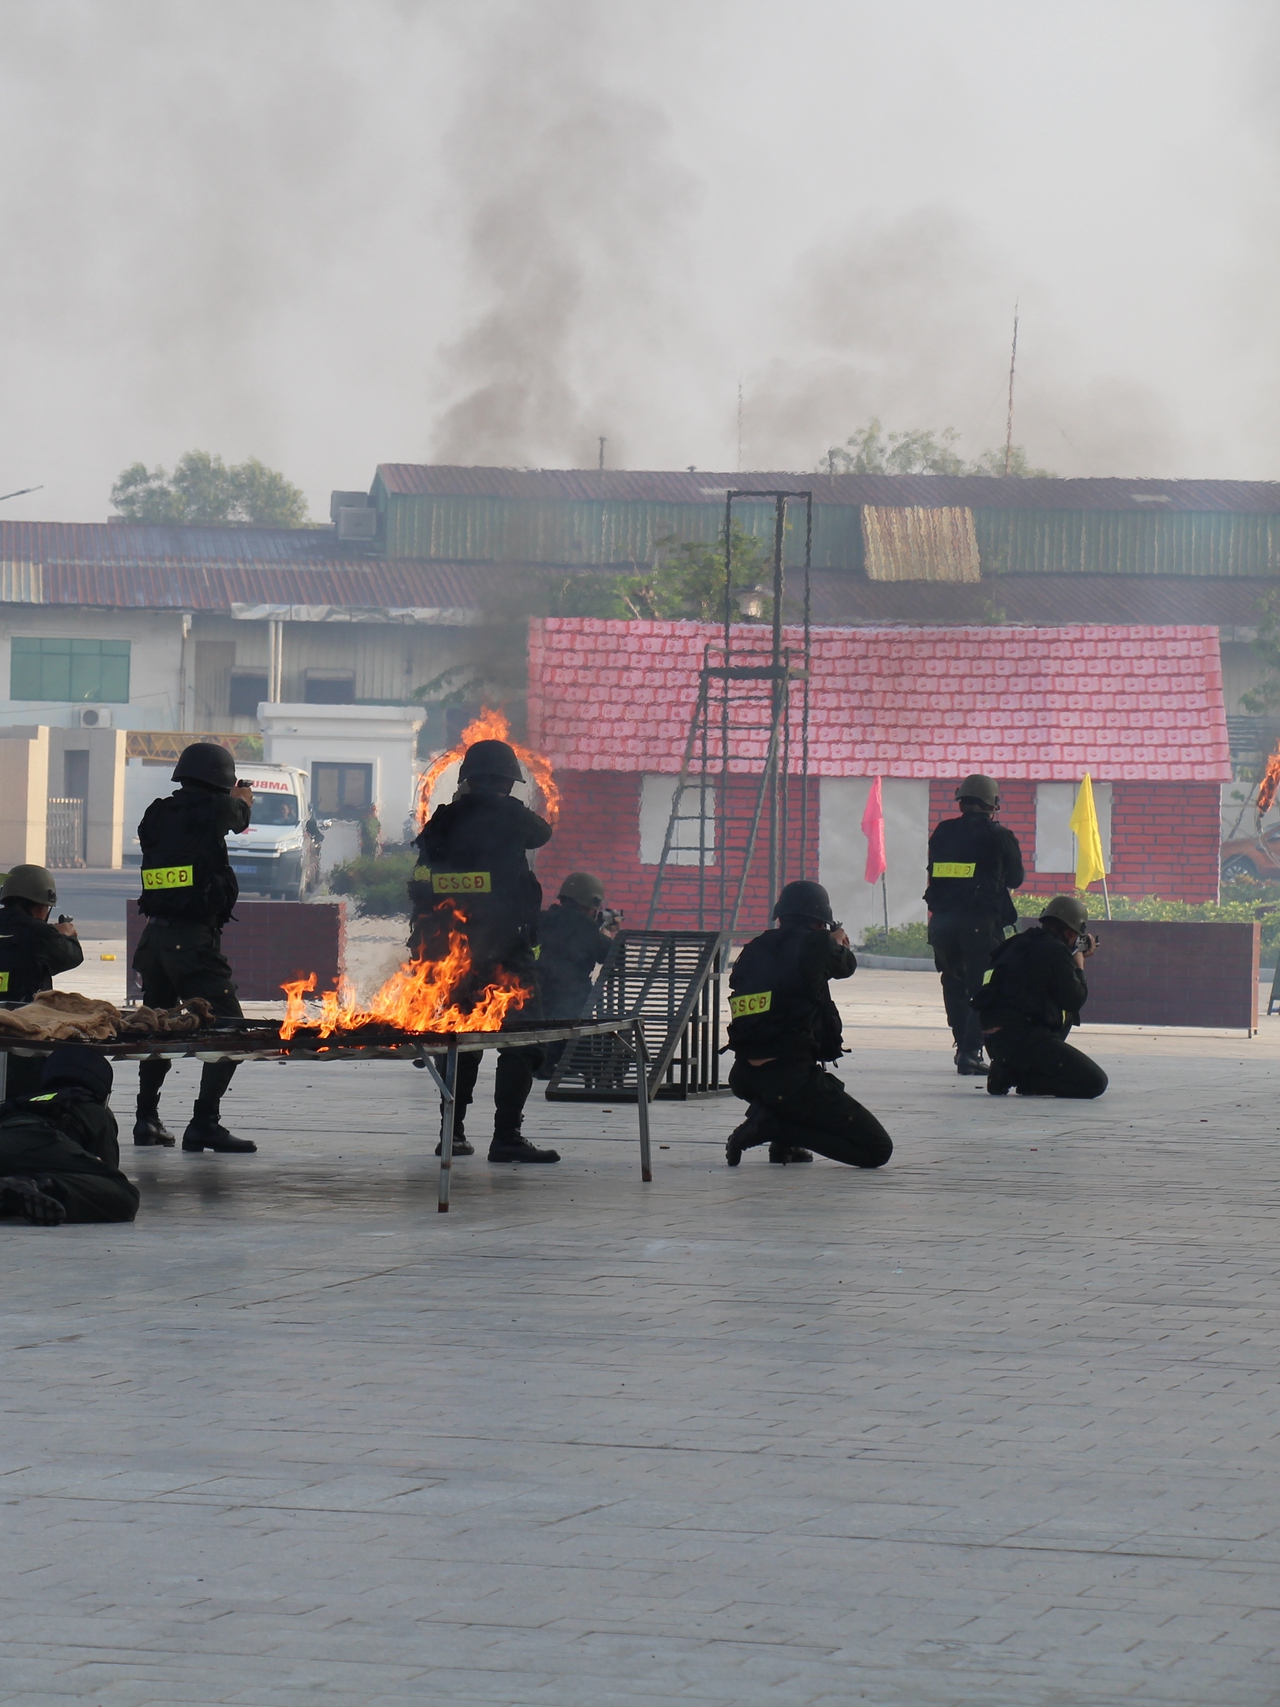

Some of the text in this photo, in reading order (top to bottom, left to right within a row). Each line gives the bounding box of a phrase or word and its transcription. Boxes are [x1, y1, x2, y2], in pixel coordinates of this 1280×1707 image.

[145, 871, 188, 886] CSCĐ
[438, 875, 485, 890] CSCĐ
[731, 996, 767, 1015] CSCĐ
